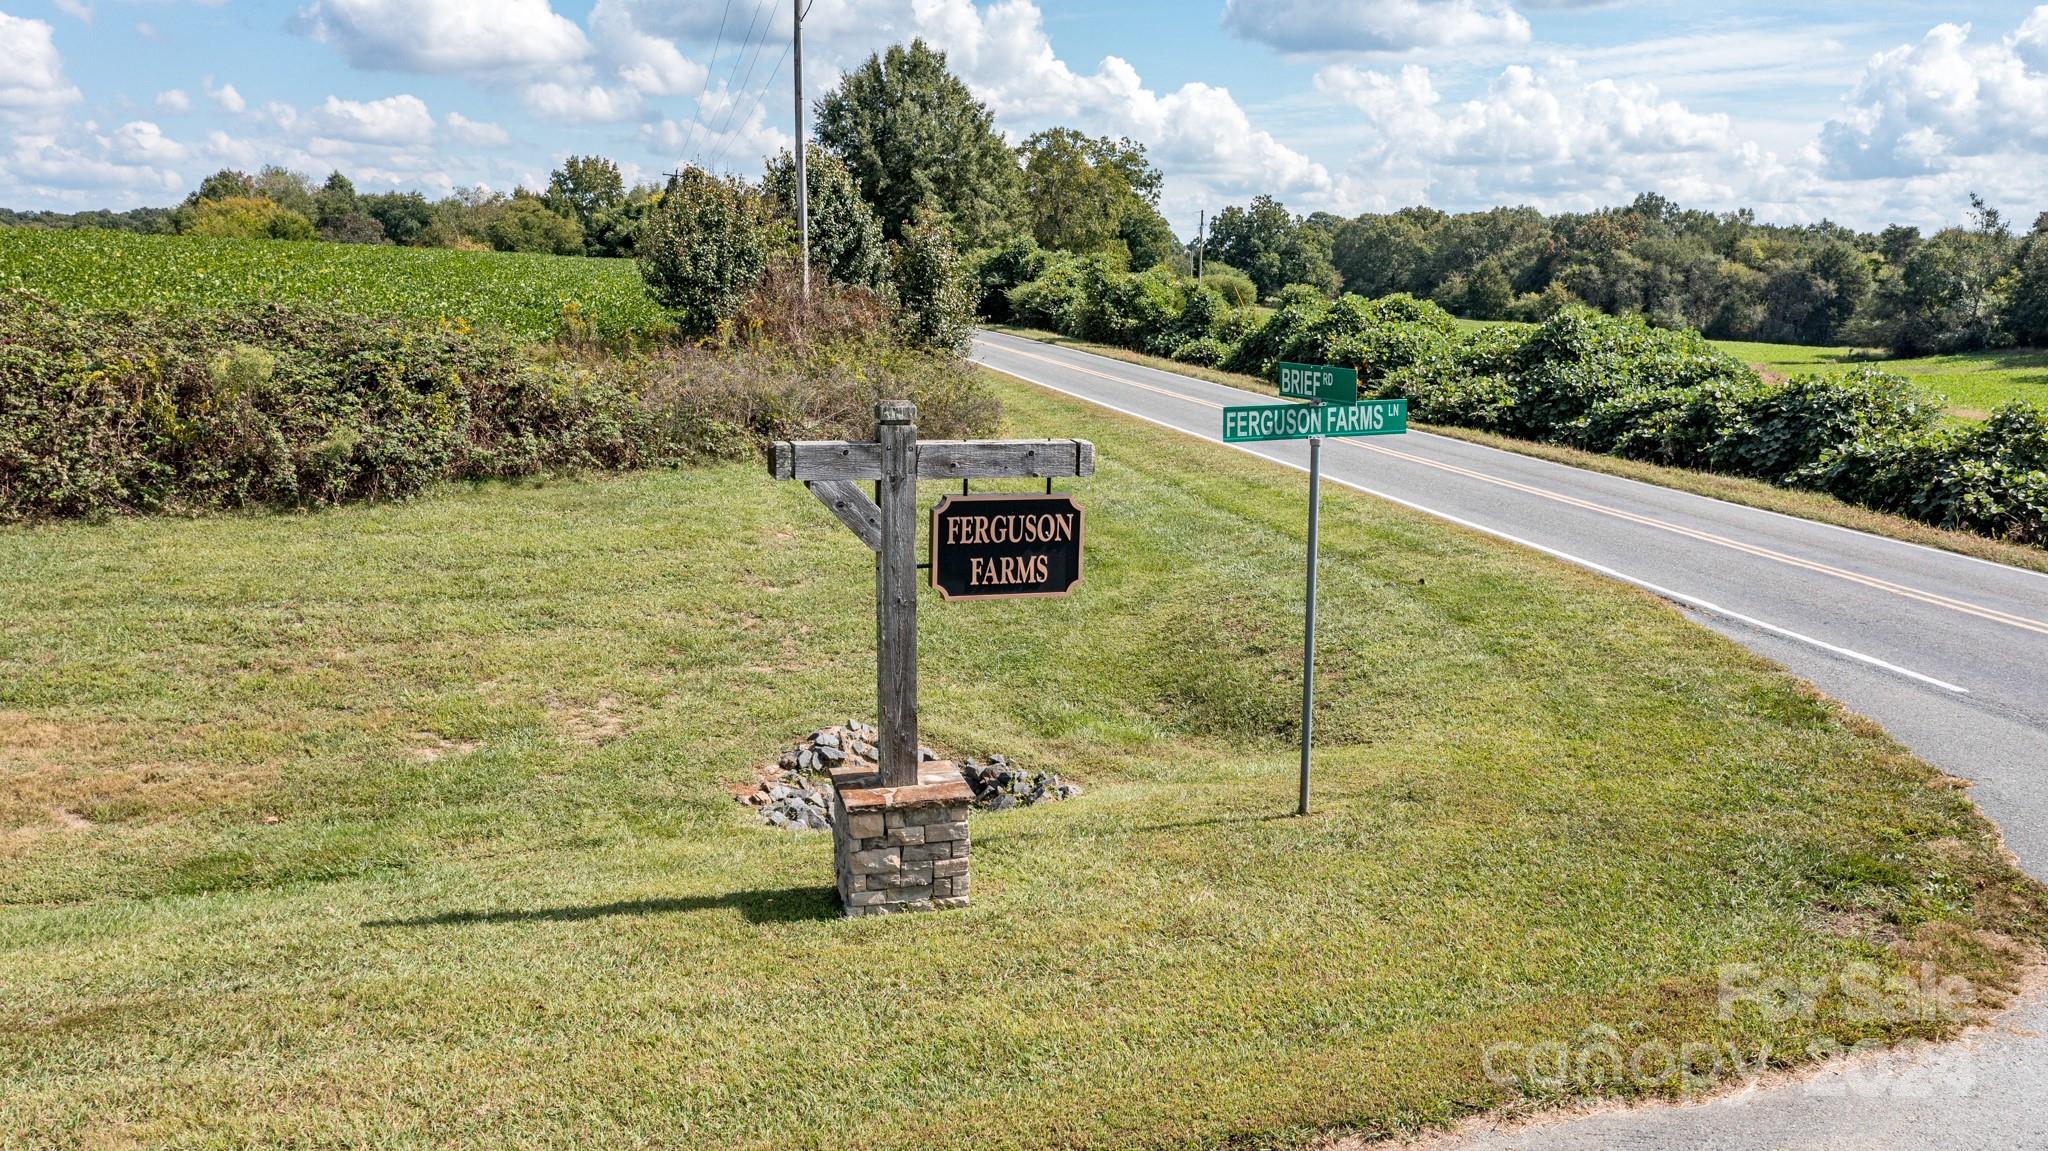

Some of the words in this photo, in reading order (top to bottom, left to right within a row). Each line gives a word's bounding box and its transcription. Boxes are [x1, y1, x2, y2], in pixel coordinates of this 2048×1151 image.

[1281, 368, 1321, 396] BRIEF
[1322, 372, 1334, 386] RD
[1226, 408, 1322, 438] FERGUSON
[1327, 404, 1384, 432] FARMS
[1388, 404, 1399, 417] LN
[946, 513, 1074, 545] FERGUSON
[970, 554, 1049, 586] FARMS
